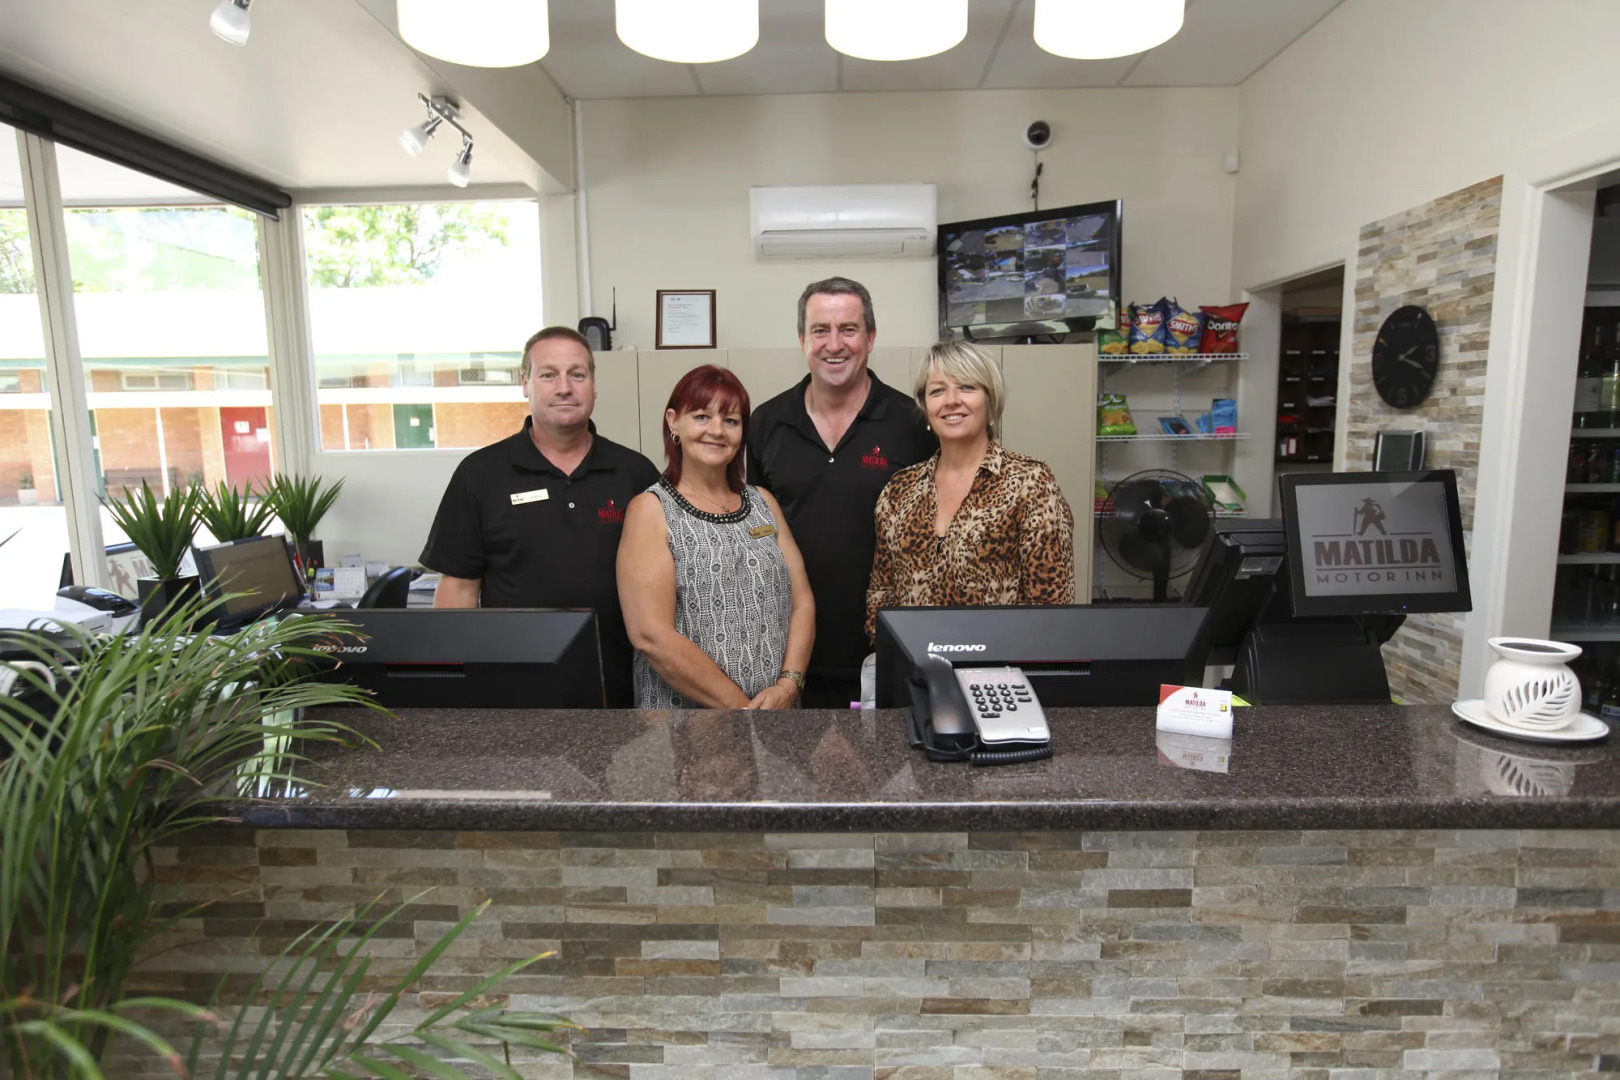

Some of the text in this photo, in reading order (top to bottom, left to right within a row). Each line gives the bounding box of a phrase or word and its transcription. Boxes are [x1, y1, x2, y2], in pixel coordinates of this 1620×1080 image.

[1425, 344, 1436, 362] 3
[1314, 538, 1440, 566] MATILDA
[1317, 570, 1442, 584] MOTOR INN
[927, 642, 987, 652] lenovo
[1185, 699, 1206, 707] MATILDA
